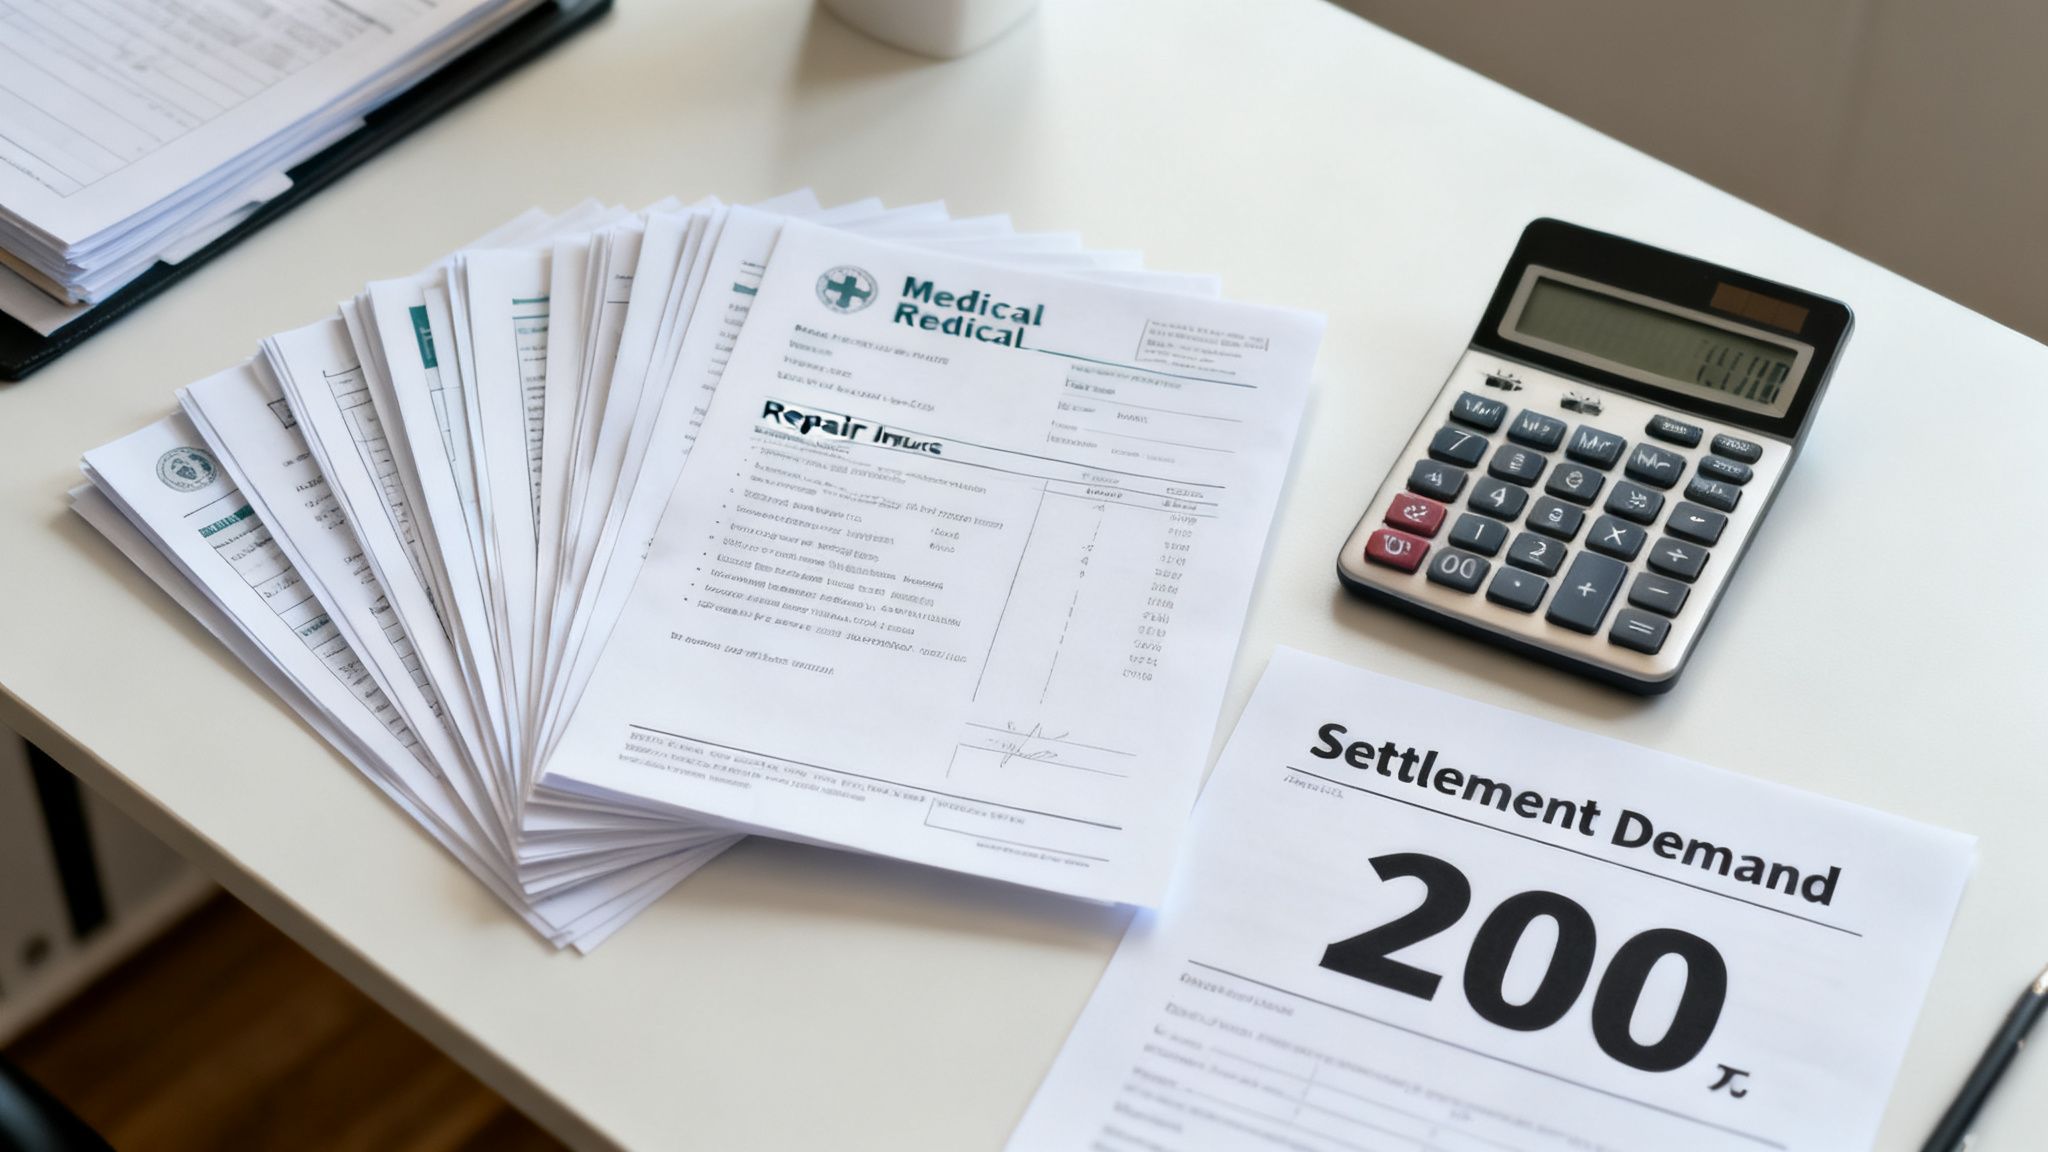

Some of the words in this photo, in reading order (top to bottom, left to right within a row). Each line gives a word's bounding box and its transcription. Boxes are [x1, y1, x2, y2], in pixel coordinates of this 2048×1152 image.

[893, 301, 1024, 349] Redical
[902, 275, 1045, 327] Medical
[1449, 430, 1473, 451] 7
[1474, 523, 1485, 541] 1
[1440, 554, 1478, 579] 00
[1309, 722, 1601, 837] Settlement
[1610, 809, 1842, 906] Demand
[1318, 852, 1728, 1073] 200
